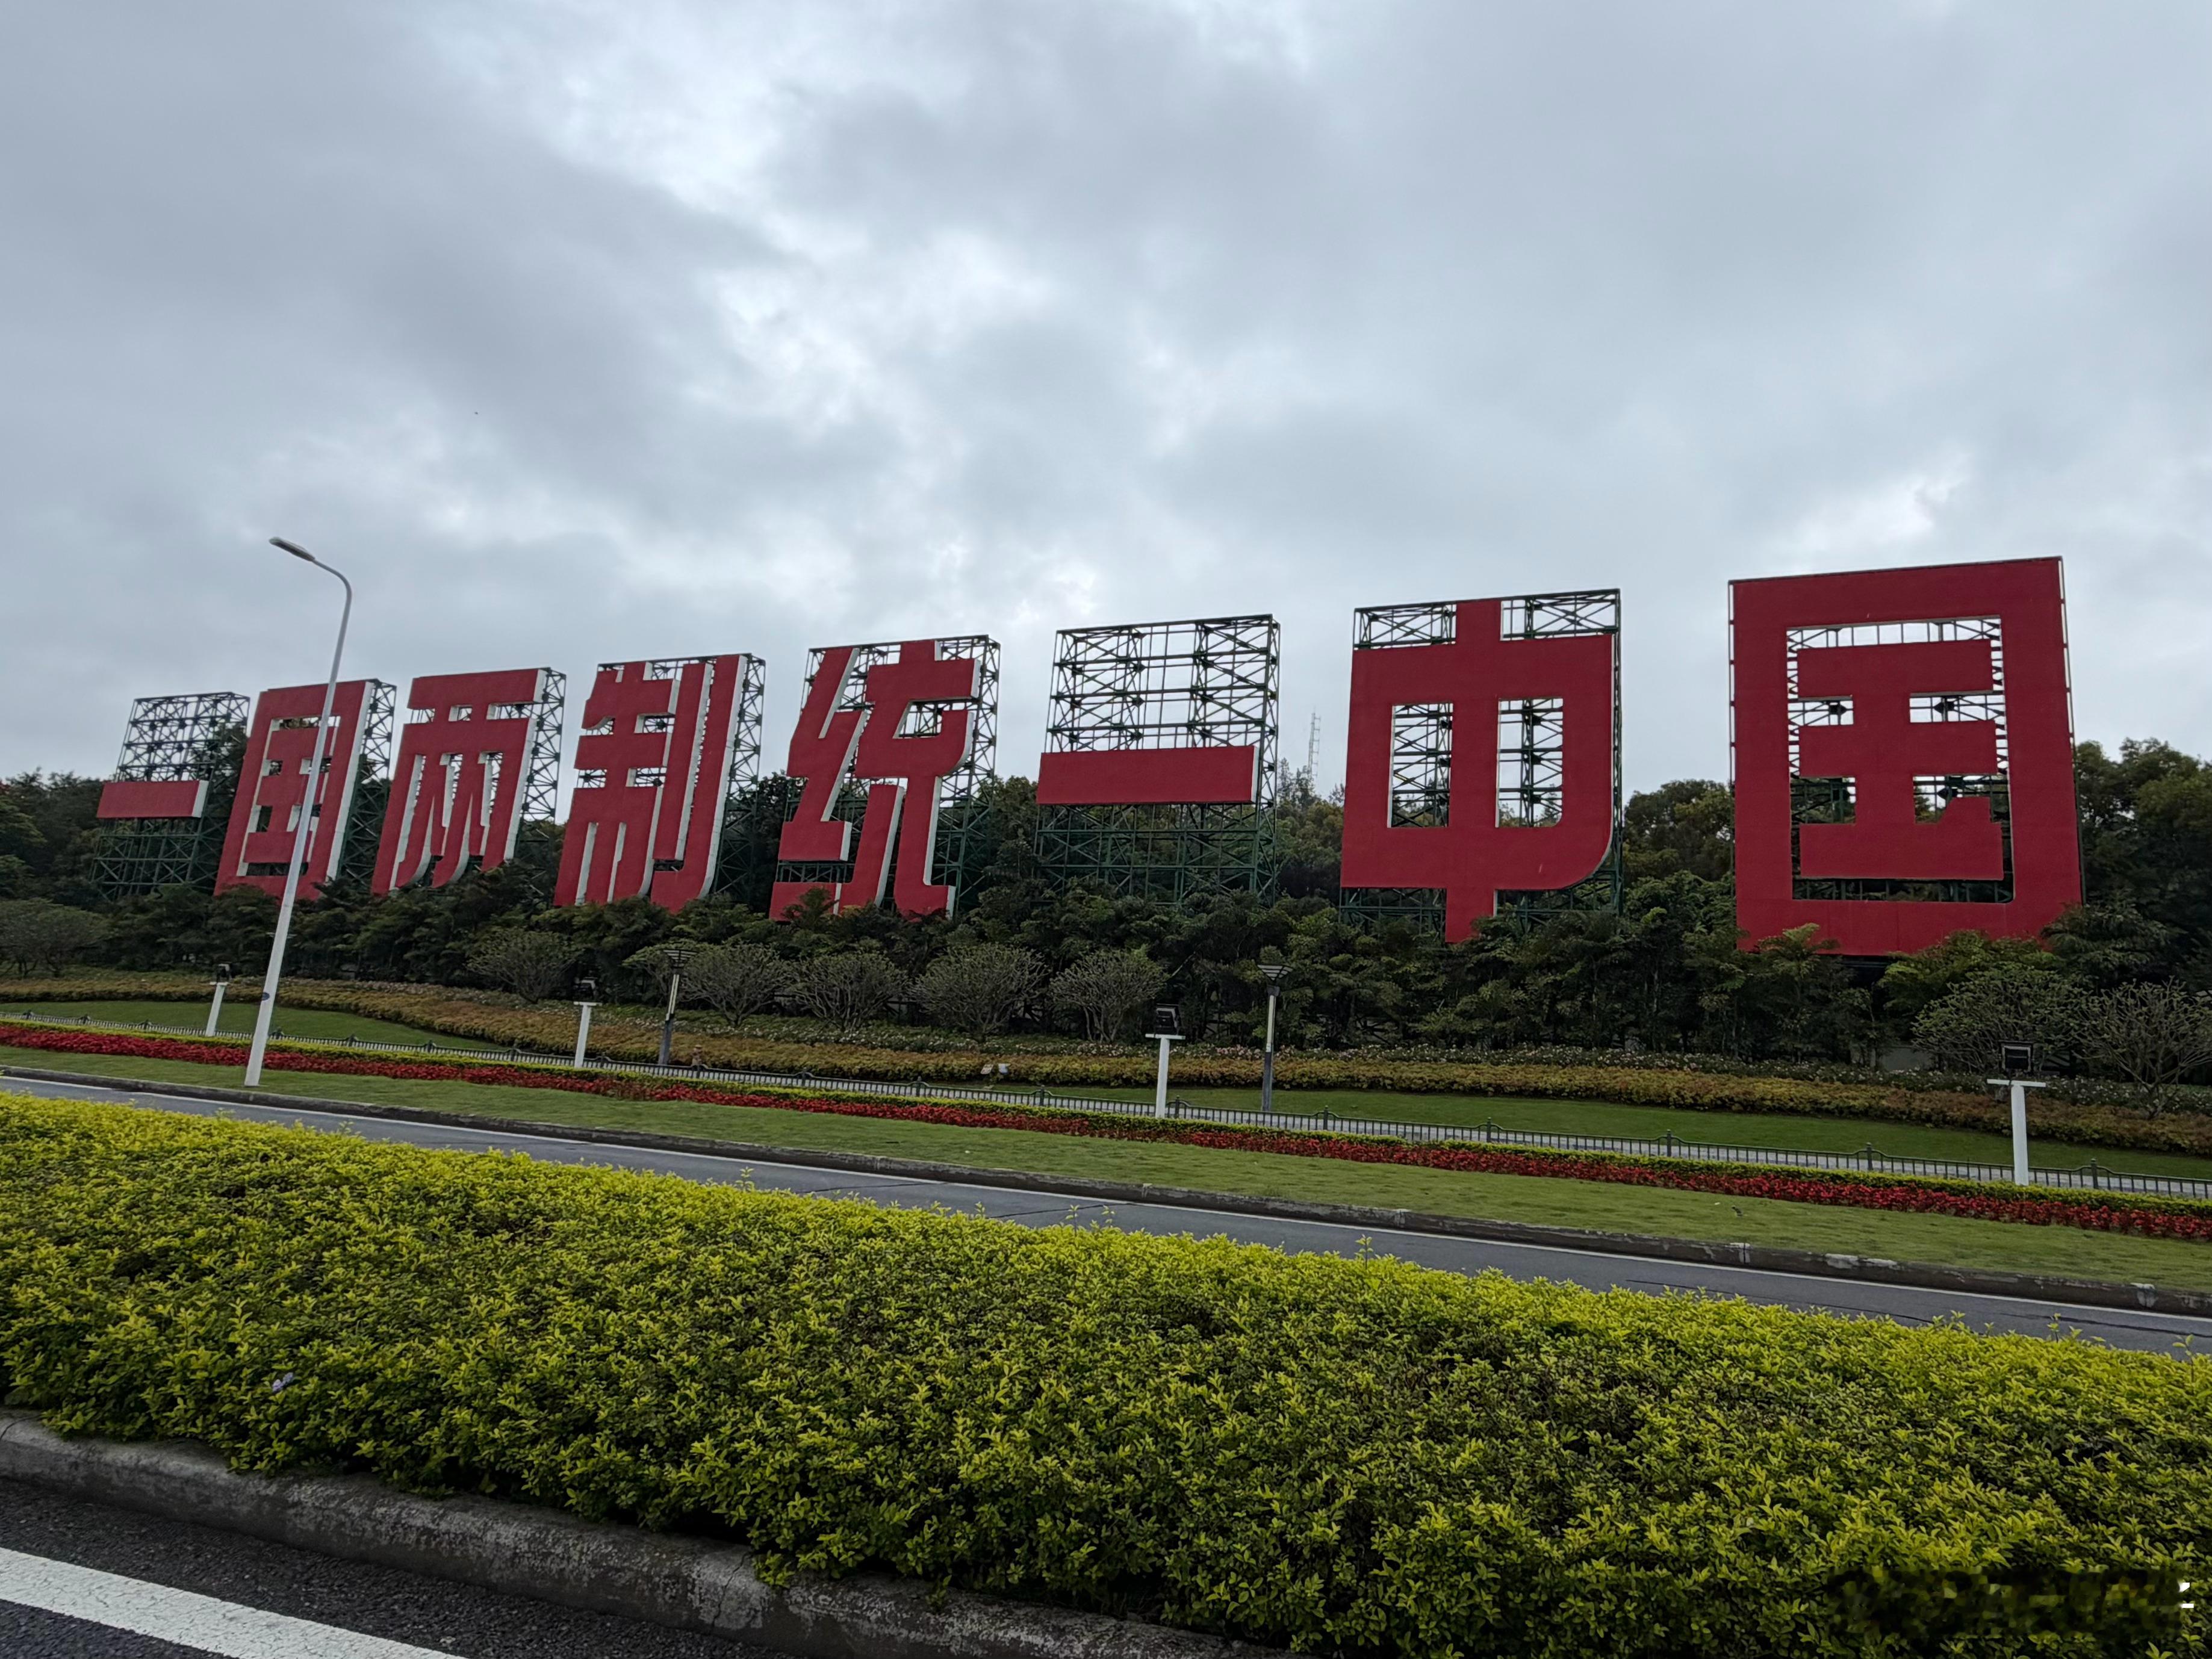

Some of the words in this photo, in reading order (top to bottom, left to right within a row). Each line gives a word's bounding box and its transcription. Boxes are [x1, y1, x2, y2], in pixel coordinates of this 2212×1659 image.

[97, 557, 2083, 957] 一国两制统一中国
